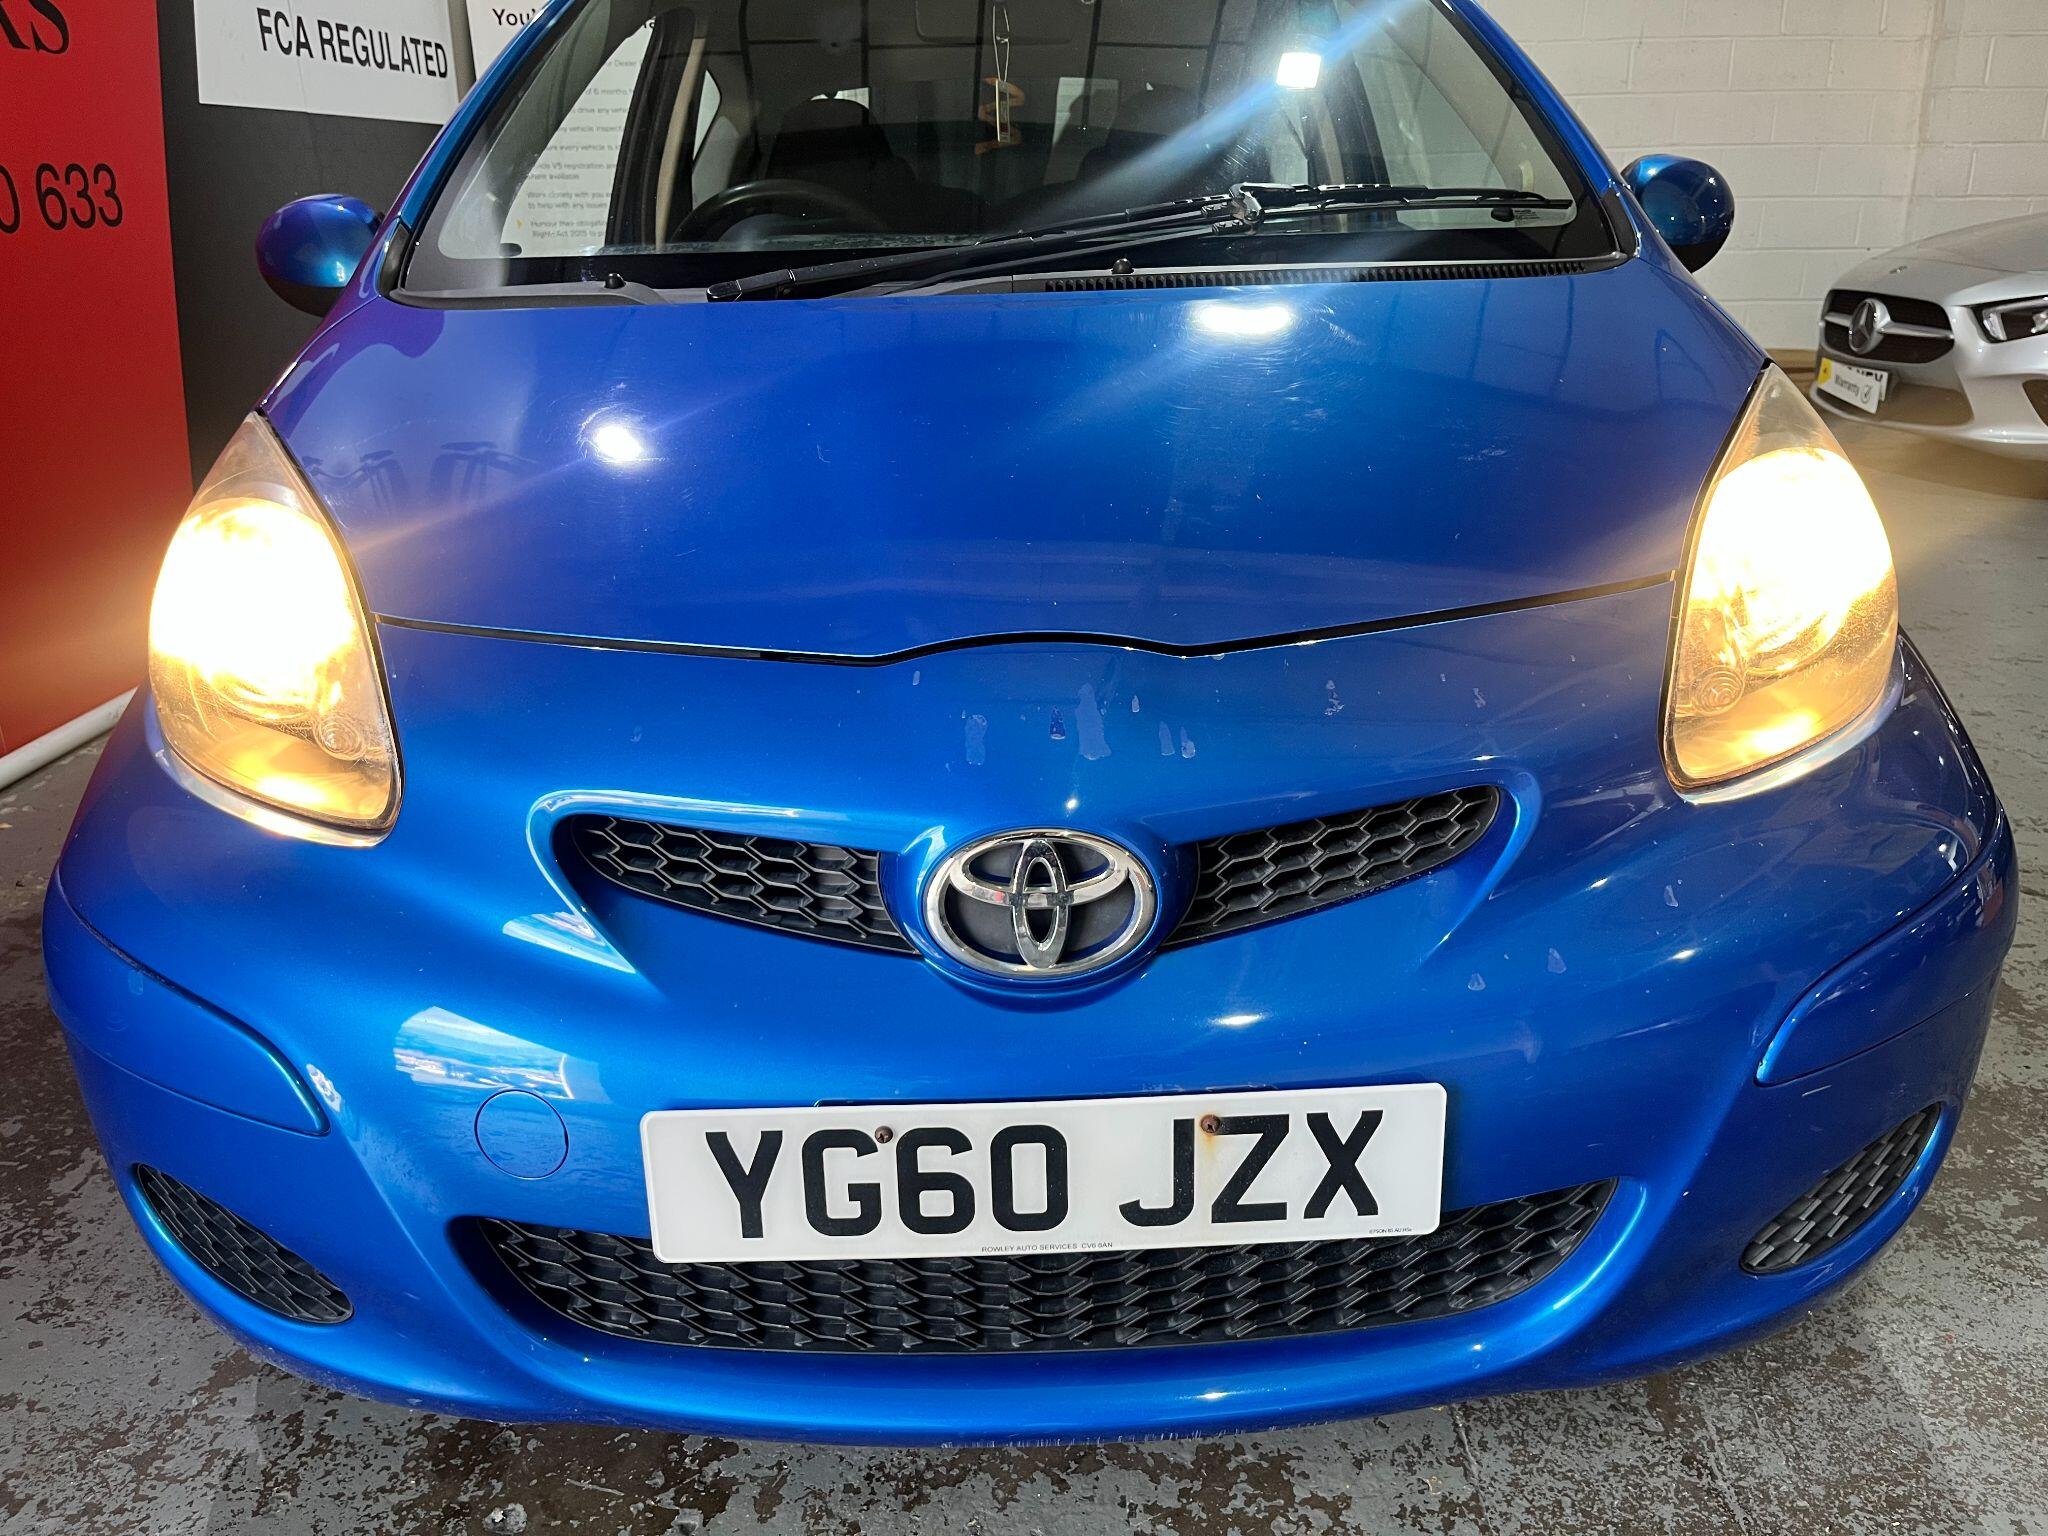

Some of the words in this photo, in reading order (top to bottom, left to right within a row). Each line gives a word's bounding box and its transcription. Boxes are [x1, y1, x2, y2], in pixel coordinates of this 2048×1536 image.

[256, 7, 314, 58] FCA
[317, 19, 448, 79] REGULATED
[36, 163, 123, 231] 633
[706, 1125, 1068, 1238] YG60
[1119, 1110, 1383, 1226] JZX
[981, 1245, 1014, 1253] ROWLEY
[1016, 1244, 1038, 1252] AUTO
[1039, 1243, 1078, 1251] SERVICES
